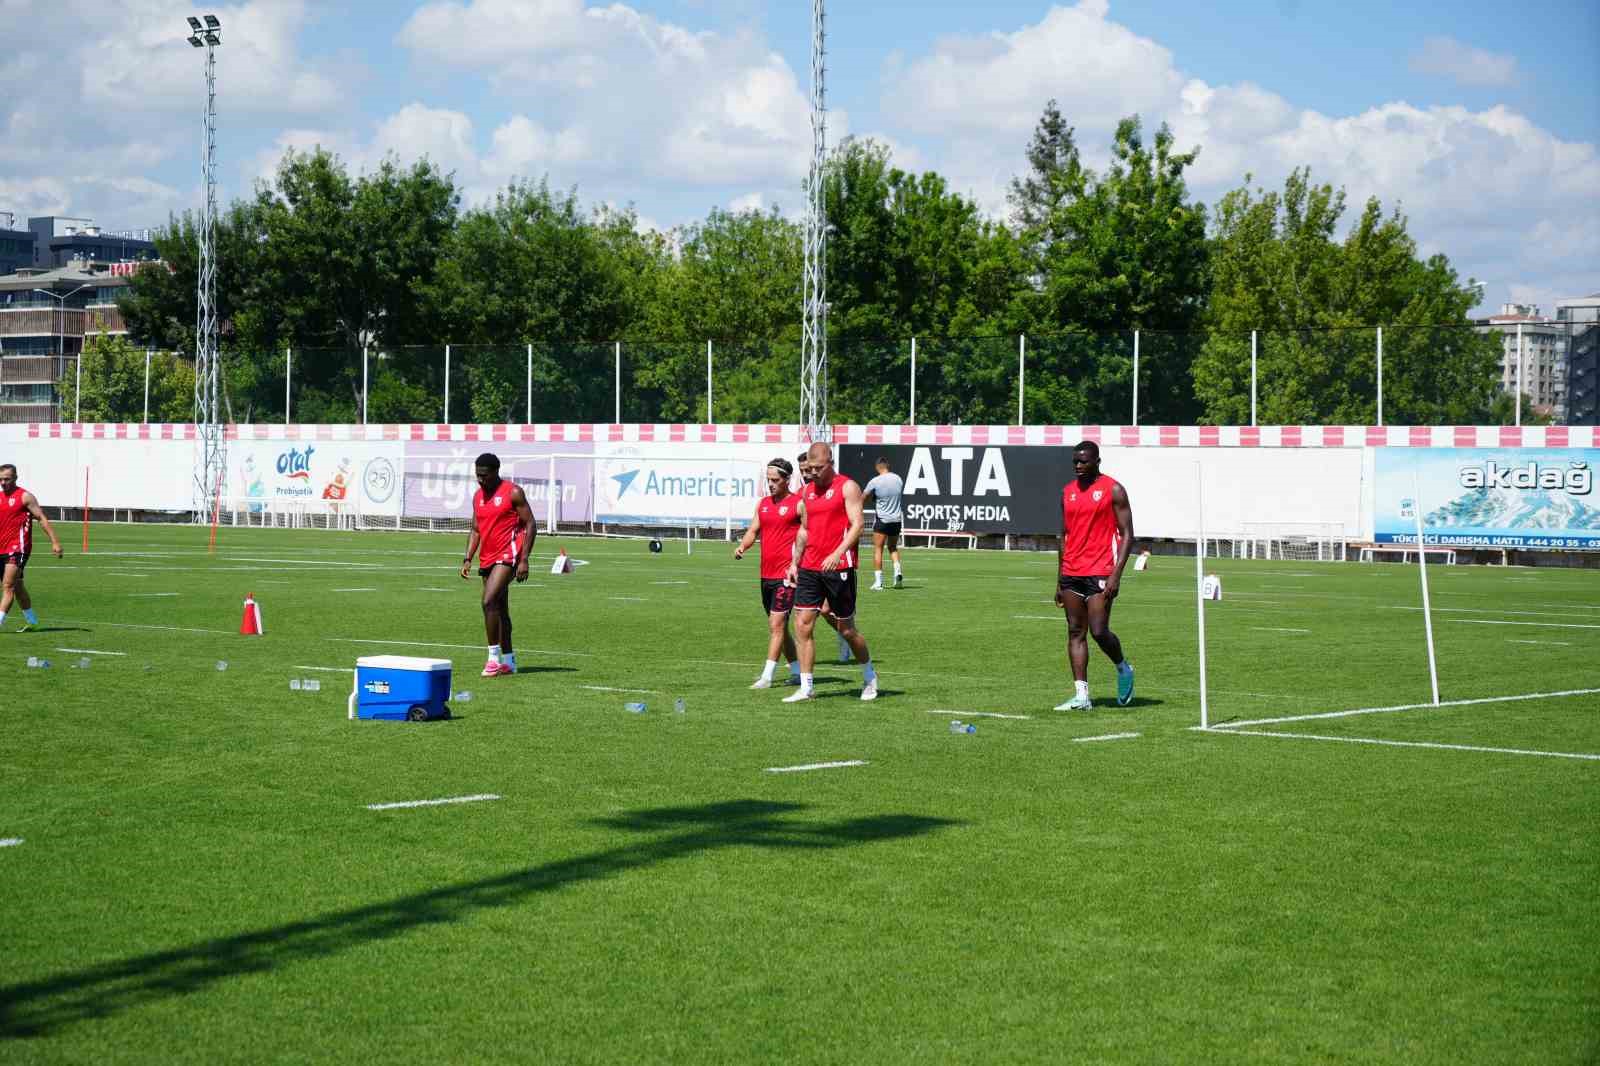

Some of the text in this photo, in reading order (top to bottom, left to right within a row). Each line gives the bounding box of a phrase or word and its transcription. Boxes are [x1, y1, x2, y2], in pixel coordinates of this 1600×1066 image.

[276, 445, 315, 474] otat
[903, 447, 1011, 496] ATA
[645, 469, 754, 497] American
[1460, 460, 1592, 495] akdağ
[907, 504, 1010, 521] SPORTS MEDIA
[1527, 538, 1548, 546] 444
